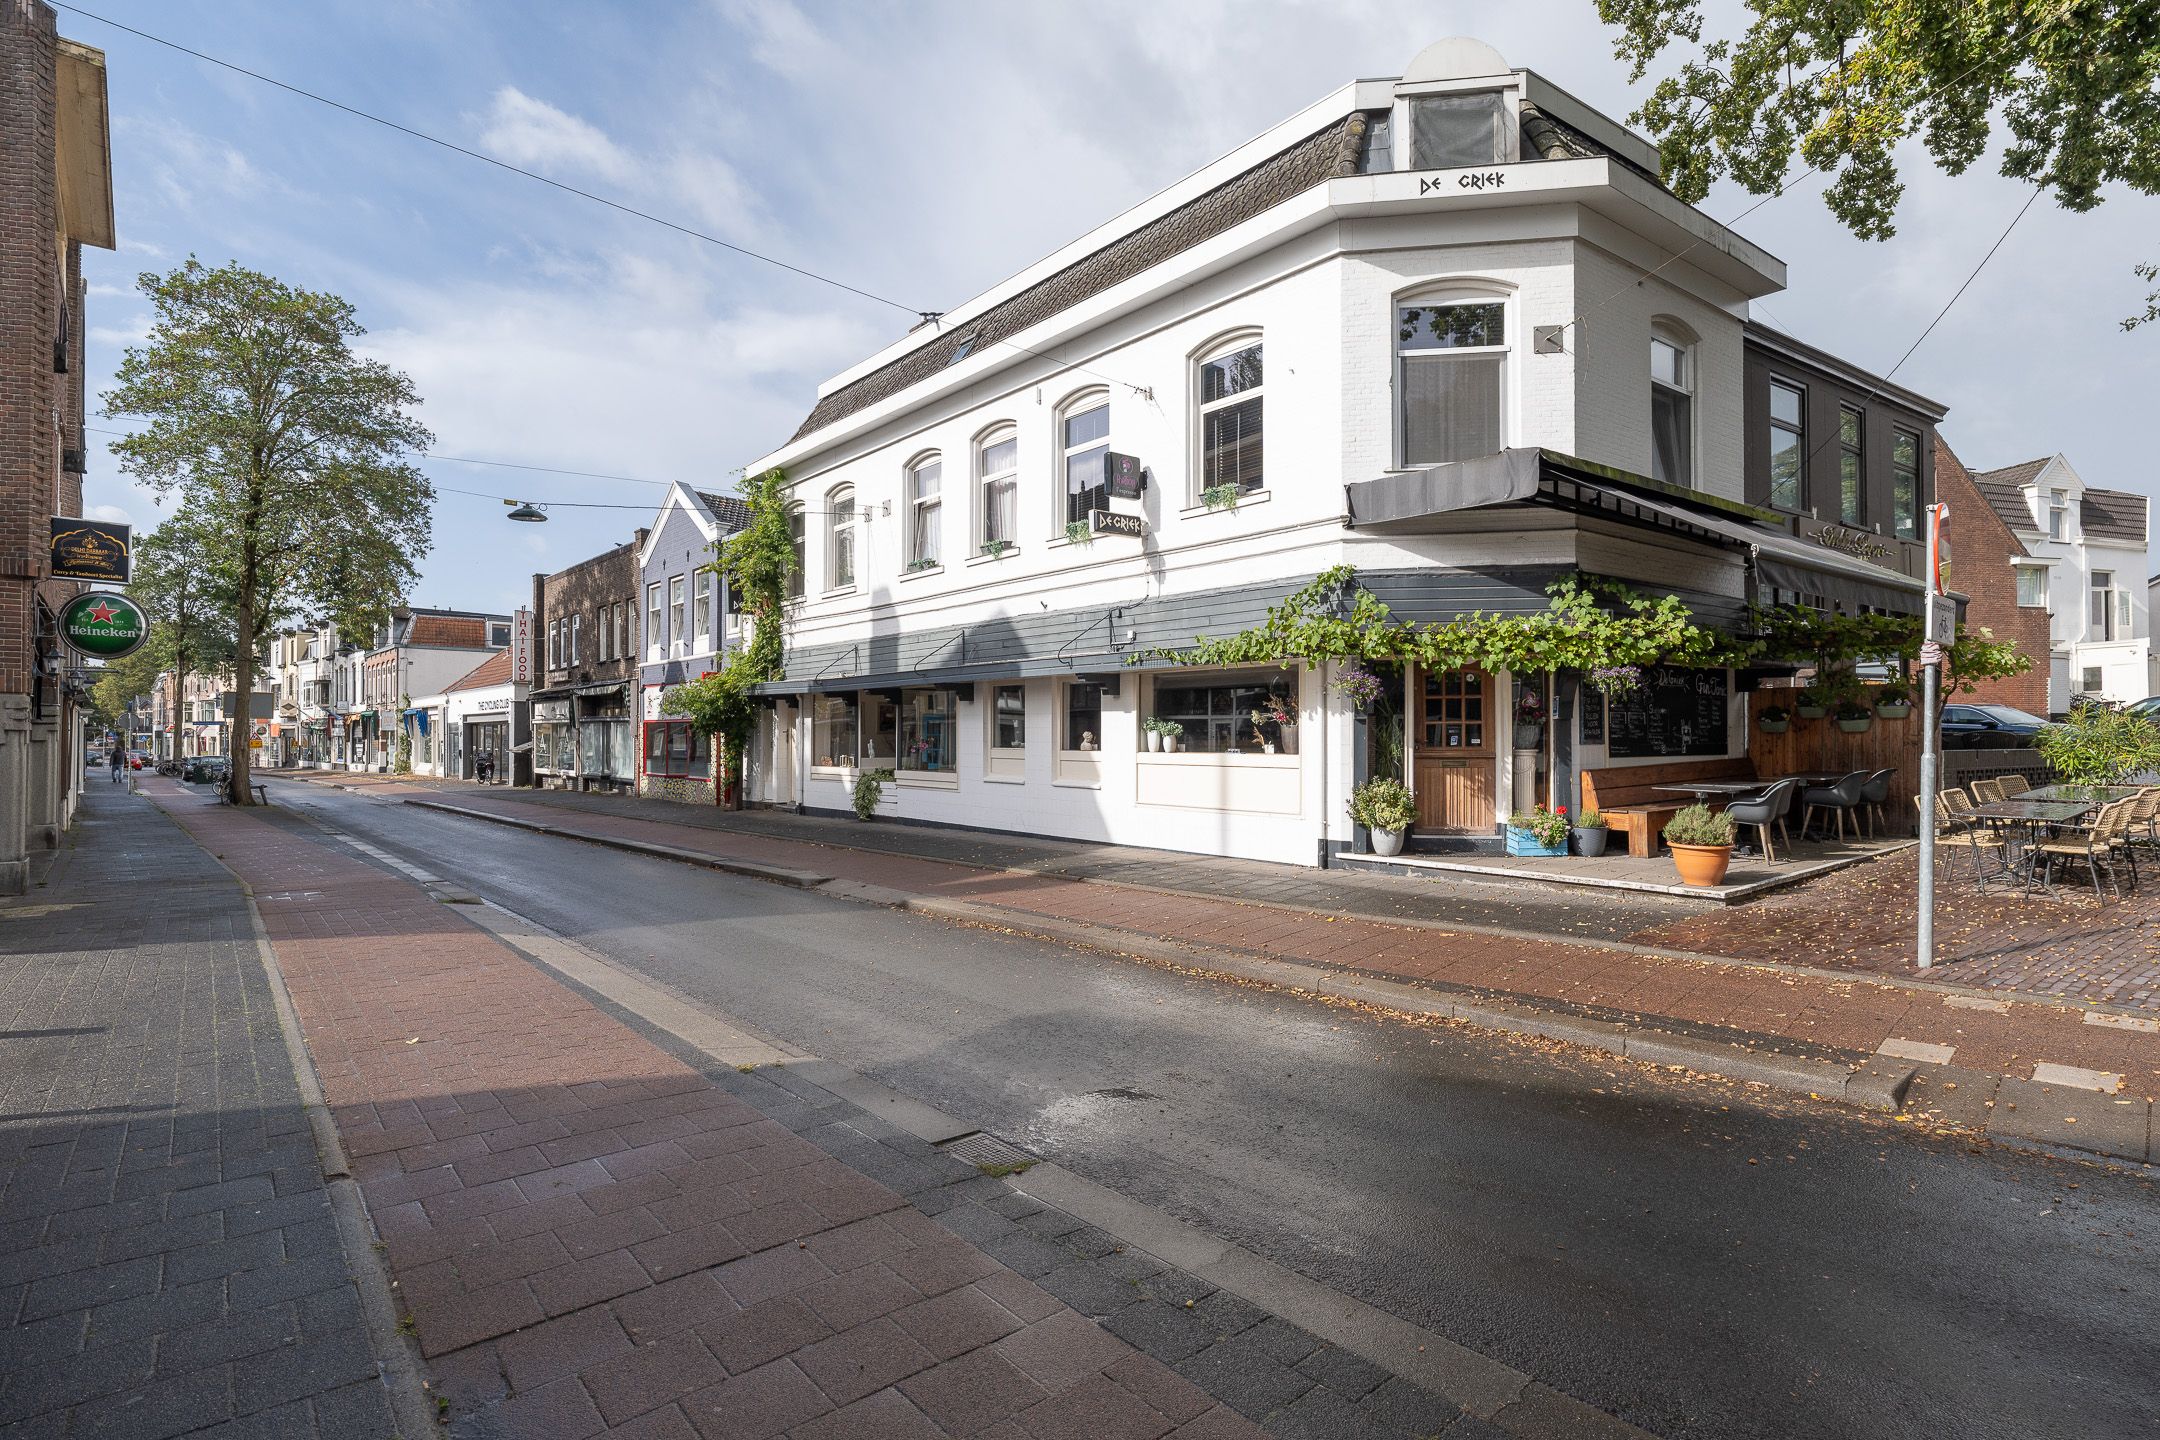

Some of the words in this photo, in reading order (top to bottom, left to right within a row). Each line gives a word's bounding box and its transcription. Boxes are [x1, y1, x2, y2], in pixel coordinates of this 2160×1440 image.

[1420, 177, 1441, 196] DE
[1458, 171, 1505, 191] GRIEK
[1099, 513, 1112, 529] DE
[1113, 516, 1142, 533] GRIEK
[69, 624, 136, 637] Heineken
[519, 611, 527, 645] THAI
[518, 647, 527, 681] FOOD
